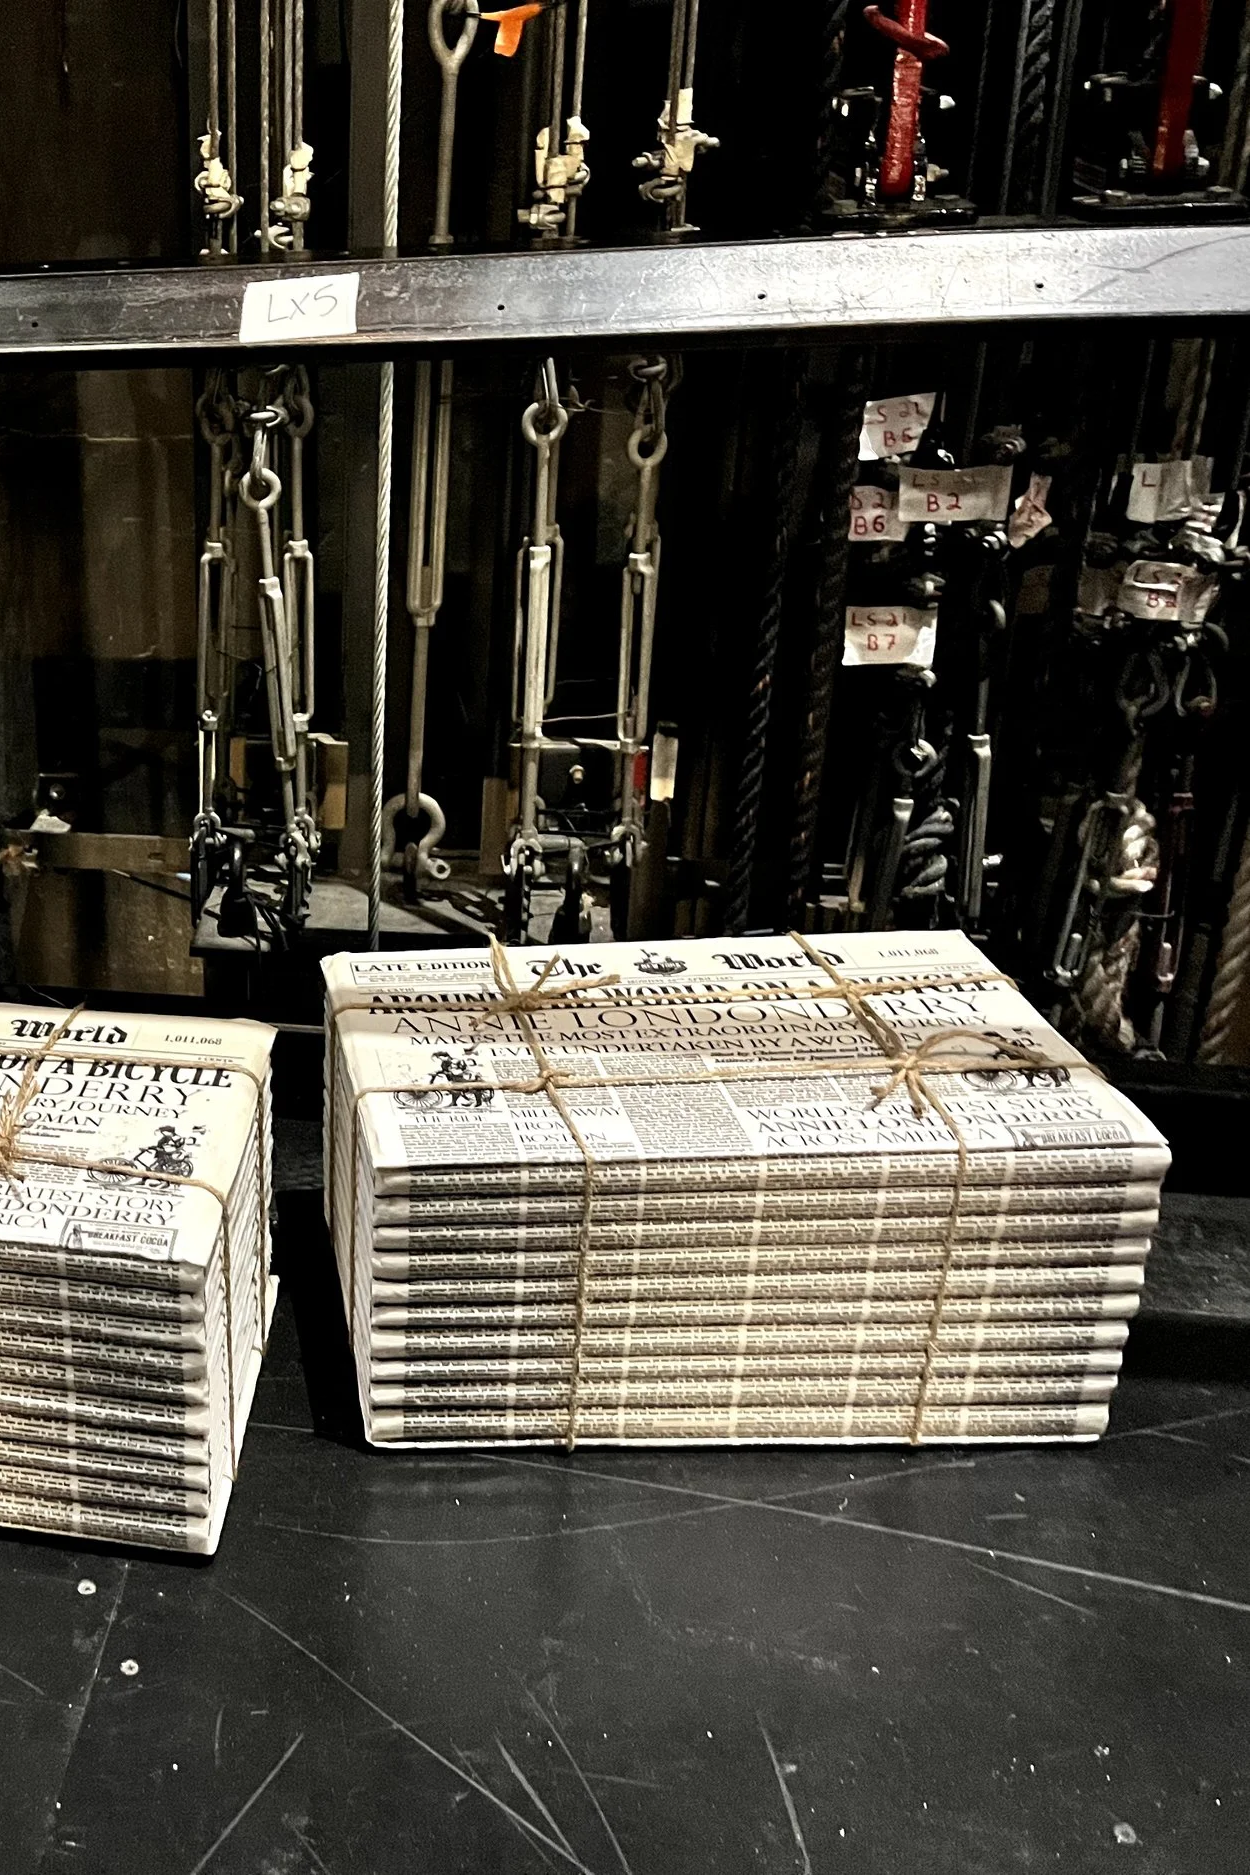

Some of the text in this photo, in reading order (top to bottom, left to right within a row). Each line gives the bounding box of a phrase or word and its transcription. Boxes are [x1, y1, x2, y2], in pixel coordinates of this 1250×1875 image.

[927, 492, 961, 512] B2
[854, 515, 885, 535] B6
[867, 634, 896, 651] B7
[354, 960, 492, 972] LATE EDITION
[526, 949, 845, 978] The World
[843, 971, 999, 996] CYCLE
[393, 1012, 552, 1034] ANNIE
[571, 995, 979, 1028] LONDONDRRY
[11, 1019, 128, 1044] World
[411, 1033, 496, 1045] MAKES
[559, 1030, 629, 1042] MOST
[635, 1020, 859, 1039] EXTRAORDINARY
[883, 1015, 988, 1029] OURNEY
[562, 1039, 744, 1055] UNDERTAKEN
[750, 1037, 781, 1048] BY
[791, 1037, 807, 1047] A
[807, 1032, 923, 1046] WOMN
[51, 1056, 75, 1075] A
[85, 1060, 232, 1088] BICYCLE
[62, 1100, 189, 1119] JOURNEY
[569, 1106, 622, 1118] AWAY
[871, 1099, 999, 1116] GRTEST
[1007, 1095, 1095, 1110] STORY
[16, 1111, 104, 1128] OMAN
[759, 1119, 853, 1133] ANNIE
[519, 1132, 608, 1143] BOSTON
[767, 1127, 996, 1147] ACROSS AMERICA
[96, 1191, 182, 1212] STORY
[87, 1230, 168, 1247] BREAKFAST COCOA
